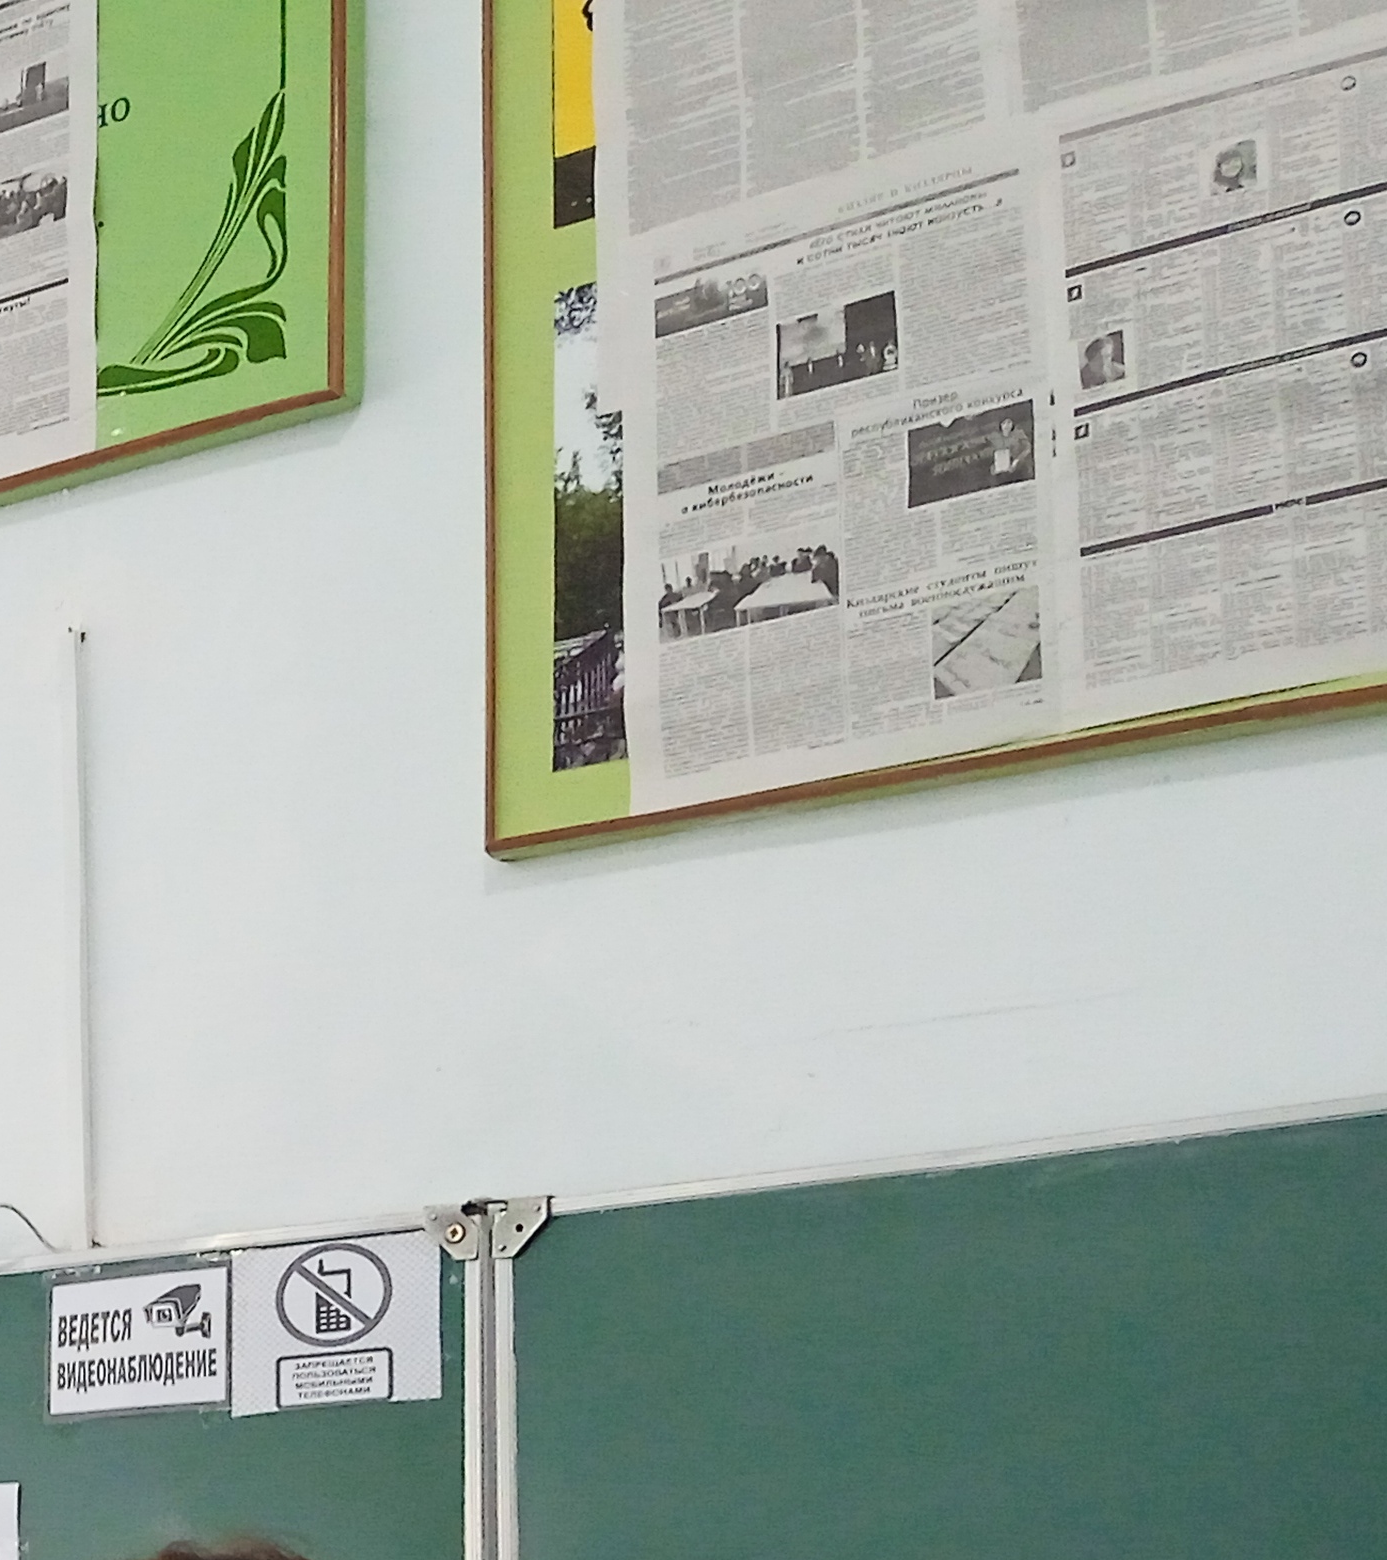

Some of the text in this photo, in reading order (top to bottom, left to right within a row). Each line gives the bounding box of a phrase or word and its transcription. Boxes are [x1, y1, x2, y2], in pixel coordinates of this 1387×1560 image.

[692, 474, 814, 512] кибербезопасности
[58, 1308, 132, 1352] ВЕДЕТСЯ
[295, 1355, 374, 1370] ЗАПРЕЩАЕТСЯ
[57, 1348, 218, 1394] ВИДЕОНАБЛЮДЕНИЕ
[292, 1366, 376, 1380] ПОЛЬЗОВАТЬСЯ
[295, 1376, 373, 1390] МОБИЛЬНЫМИ
[299, 1386, 371, 1399] ТЕЛЕФОНАМИ
